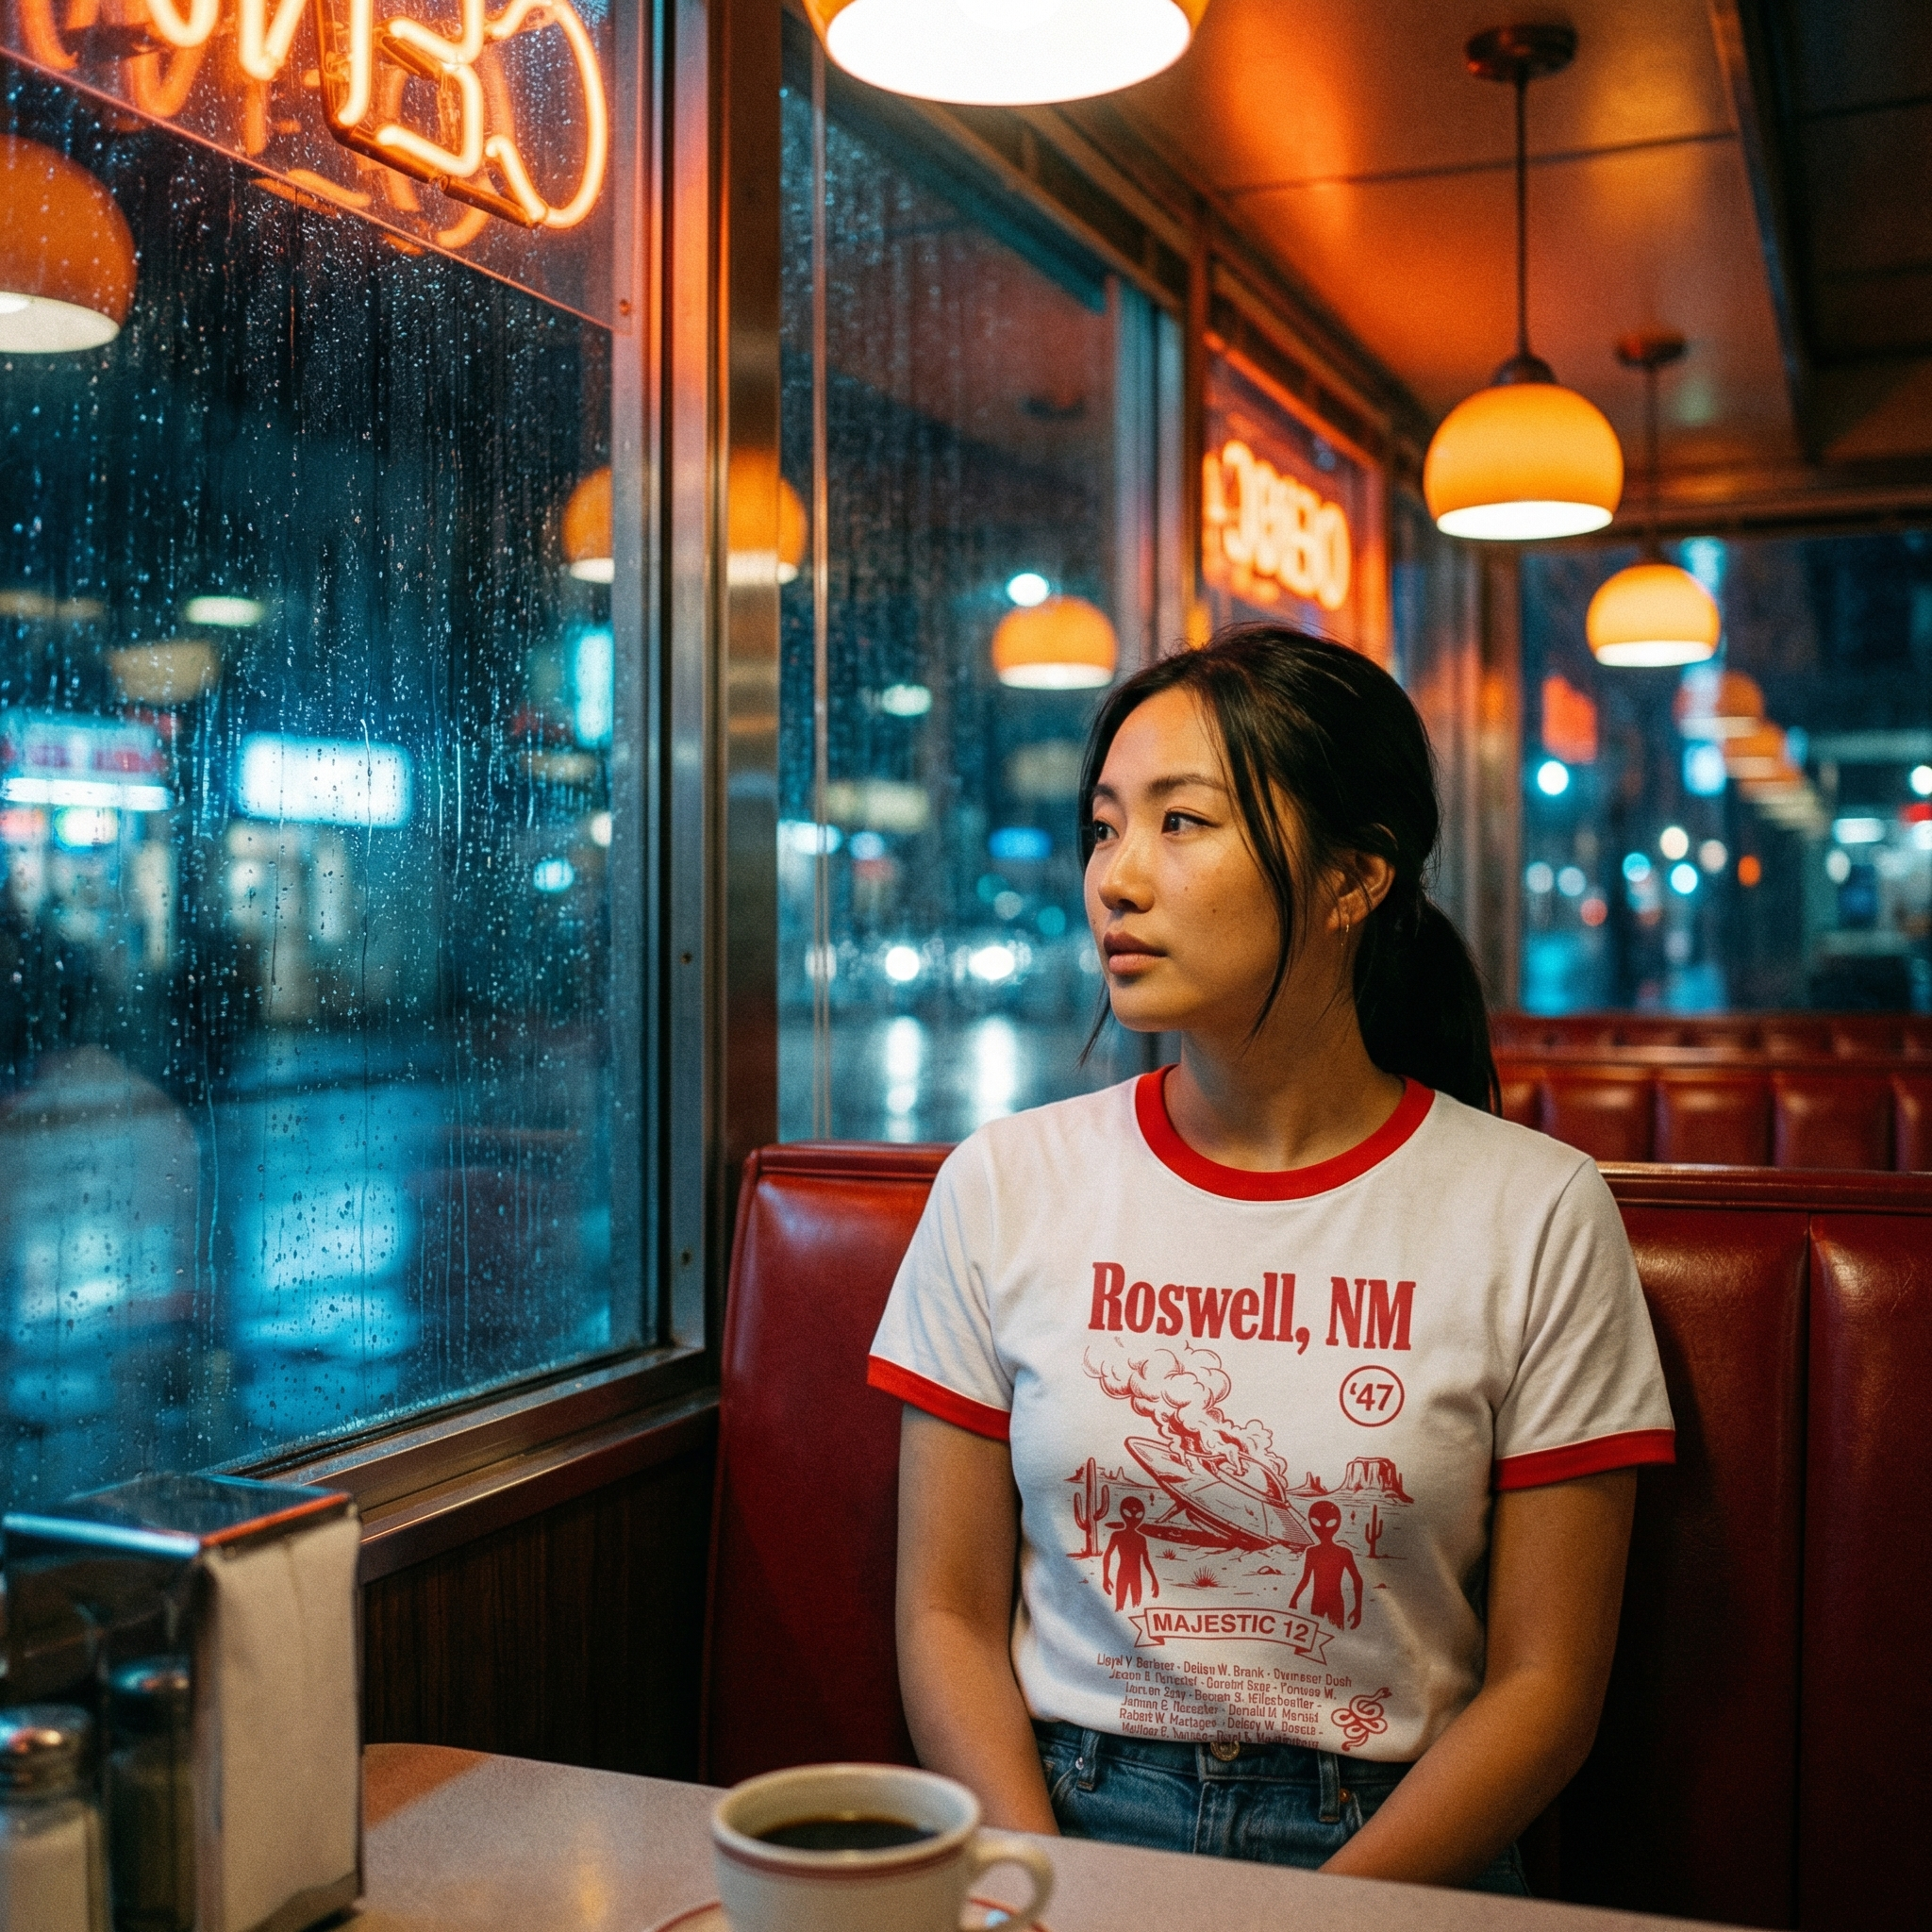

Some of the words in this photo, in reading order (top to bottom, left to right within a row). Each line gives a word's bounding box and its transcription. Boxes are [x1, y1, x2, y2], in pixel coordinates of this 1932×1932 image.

[1088, 1261, 1310, 1356] Roswell,
[1325, 1276, 1417, 1351] NM
[1153, 1613, 1276, 1635] MAJESTIC
[1283, 1620, 1309, 1642] 12
[1233, 1665, 1264, 1678] Brank
